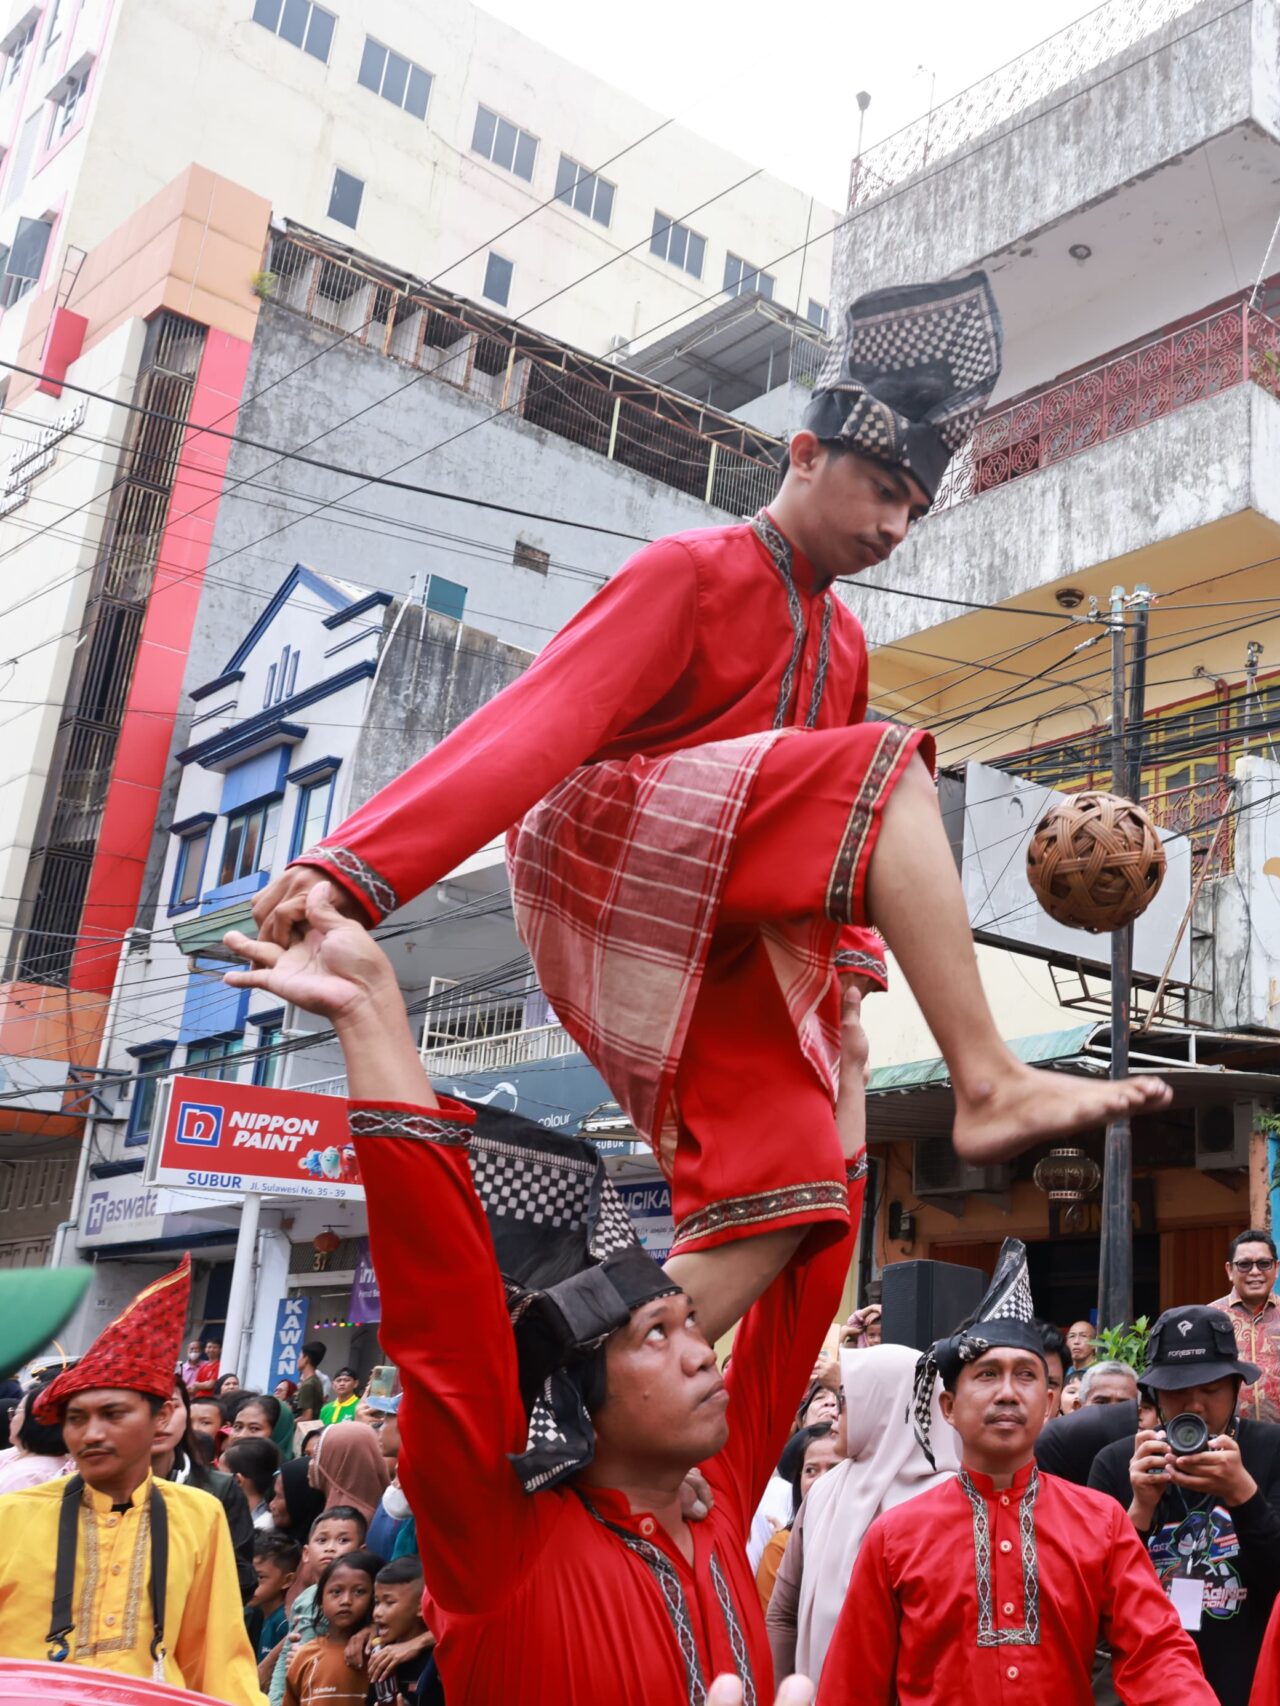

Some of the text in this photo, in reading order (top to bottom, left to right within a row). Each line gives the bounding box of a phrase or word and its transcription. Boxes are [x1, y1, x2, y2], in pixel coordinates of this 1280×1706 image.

[228, 1111, 320, 1136] NIPPON
[233, 1130, 303, 1152] PAINT
[596, 1140, 624, 1150] SUBUR
[186, 1171, 243, 1189] SUBUR
[261, 1183, 300, 1194] Sulawesi
[301, 1185, 315, 1196] No.
[317, 1187, 328, 1197] 35
[335, 1188, 347, 1198] 39
[277, 1299, 303, 1376] KAWAN
[1167, 1348, 1207, 1358] FORESTER
